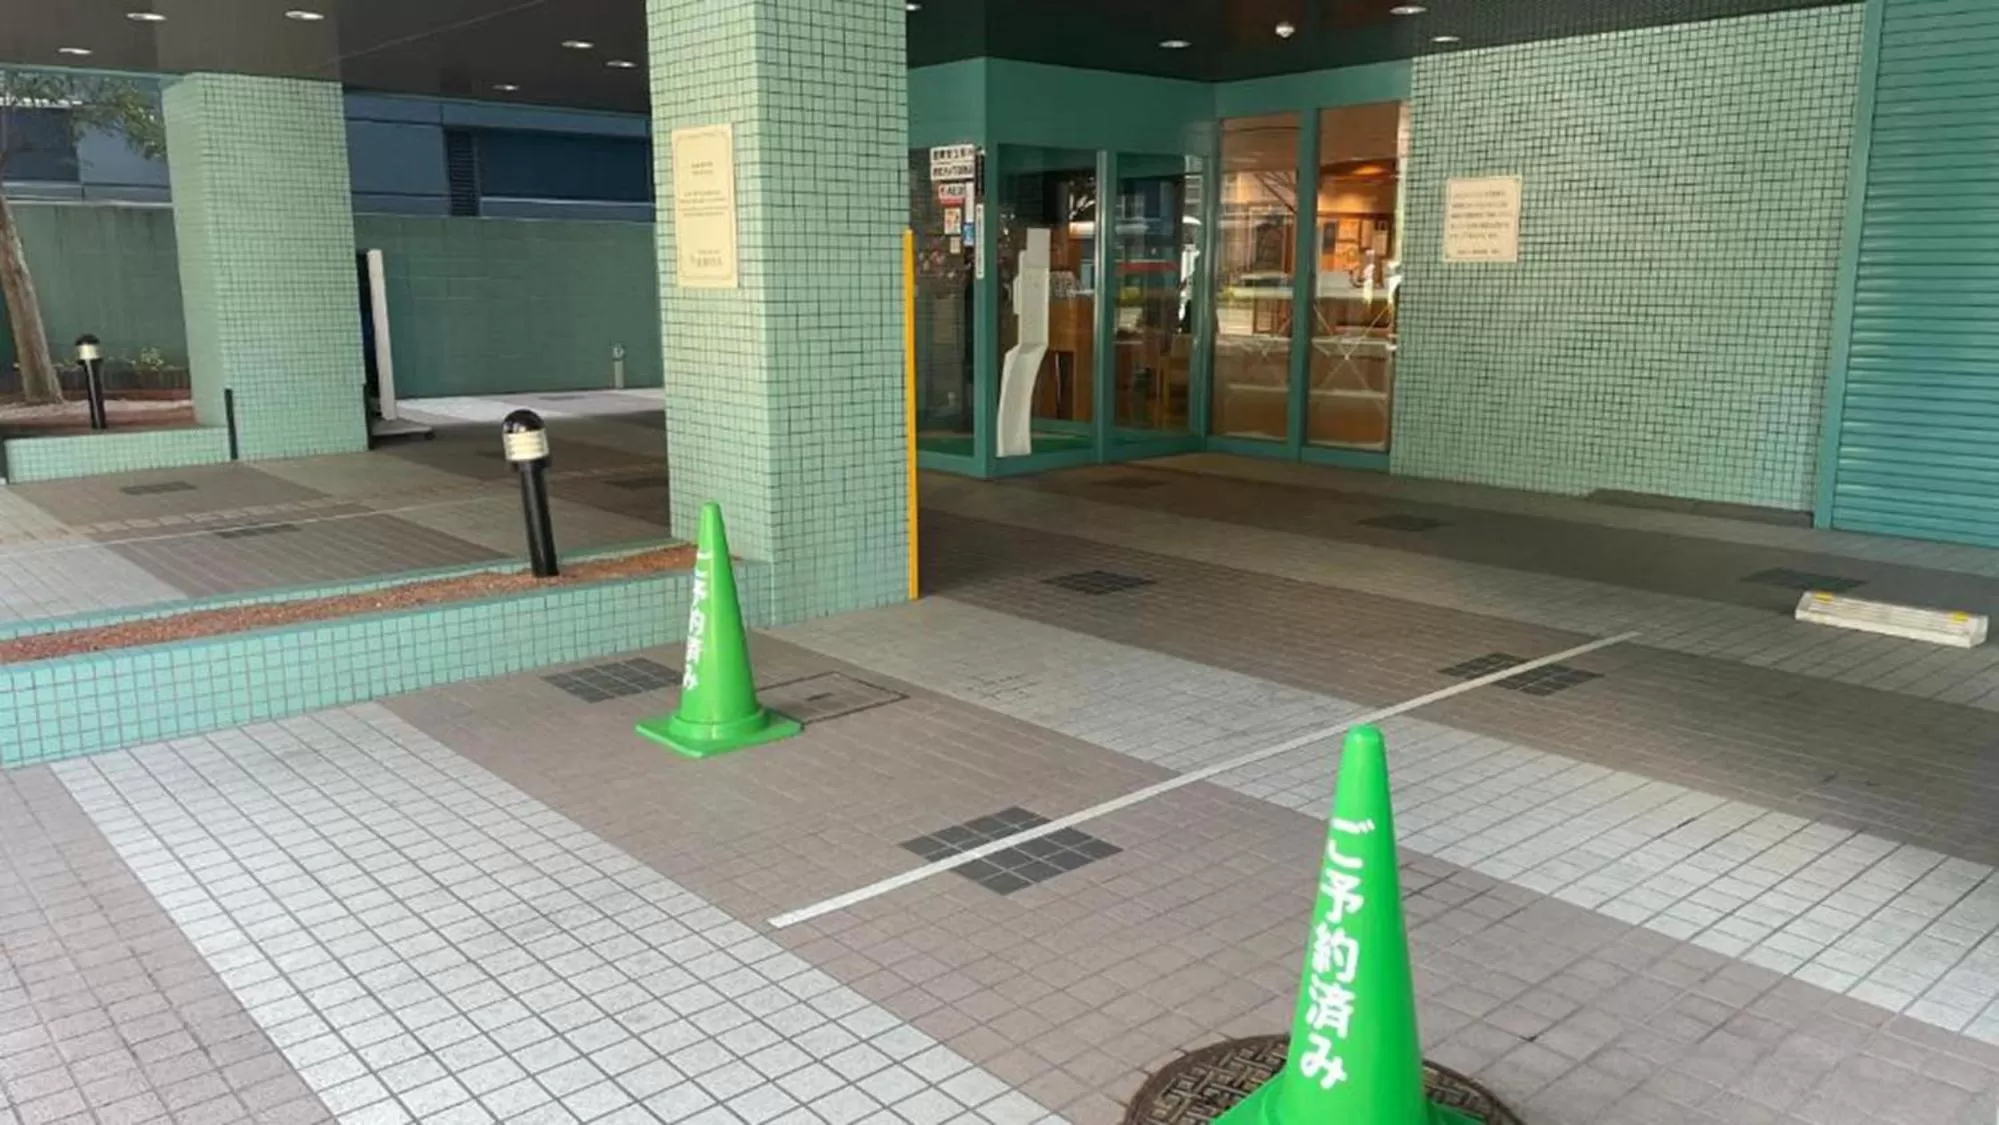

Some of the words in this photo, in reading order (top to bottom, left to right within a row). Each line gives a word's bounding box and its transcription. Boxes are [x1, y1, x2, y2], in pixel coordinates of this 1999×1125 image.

[1300, 817, 1375, 1089] ご予約済み
